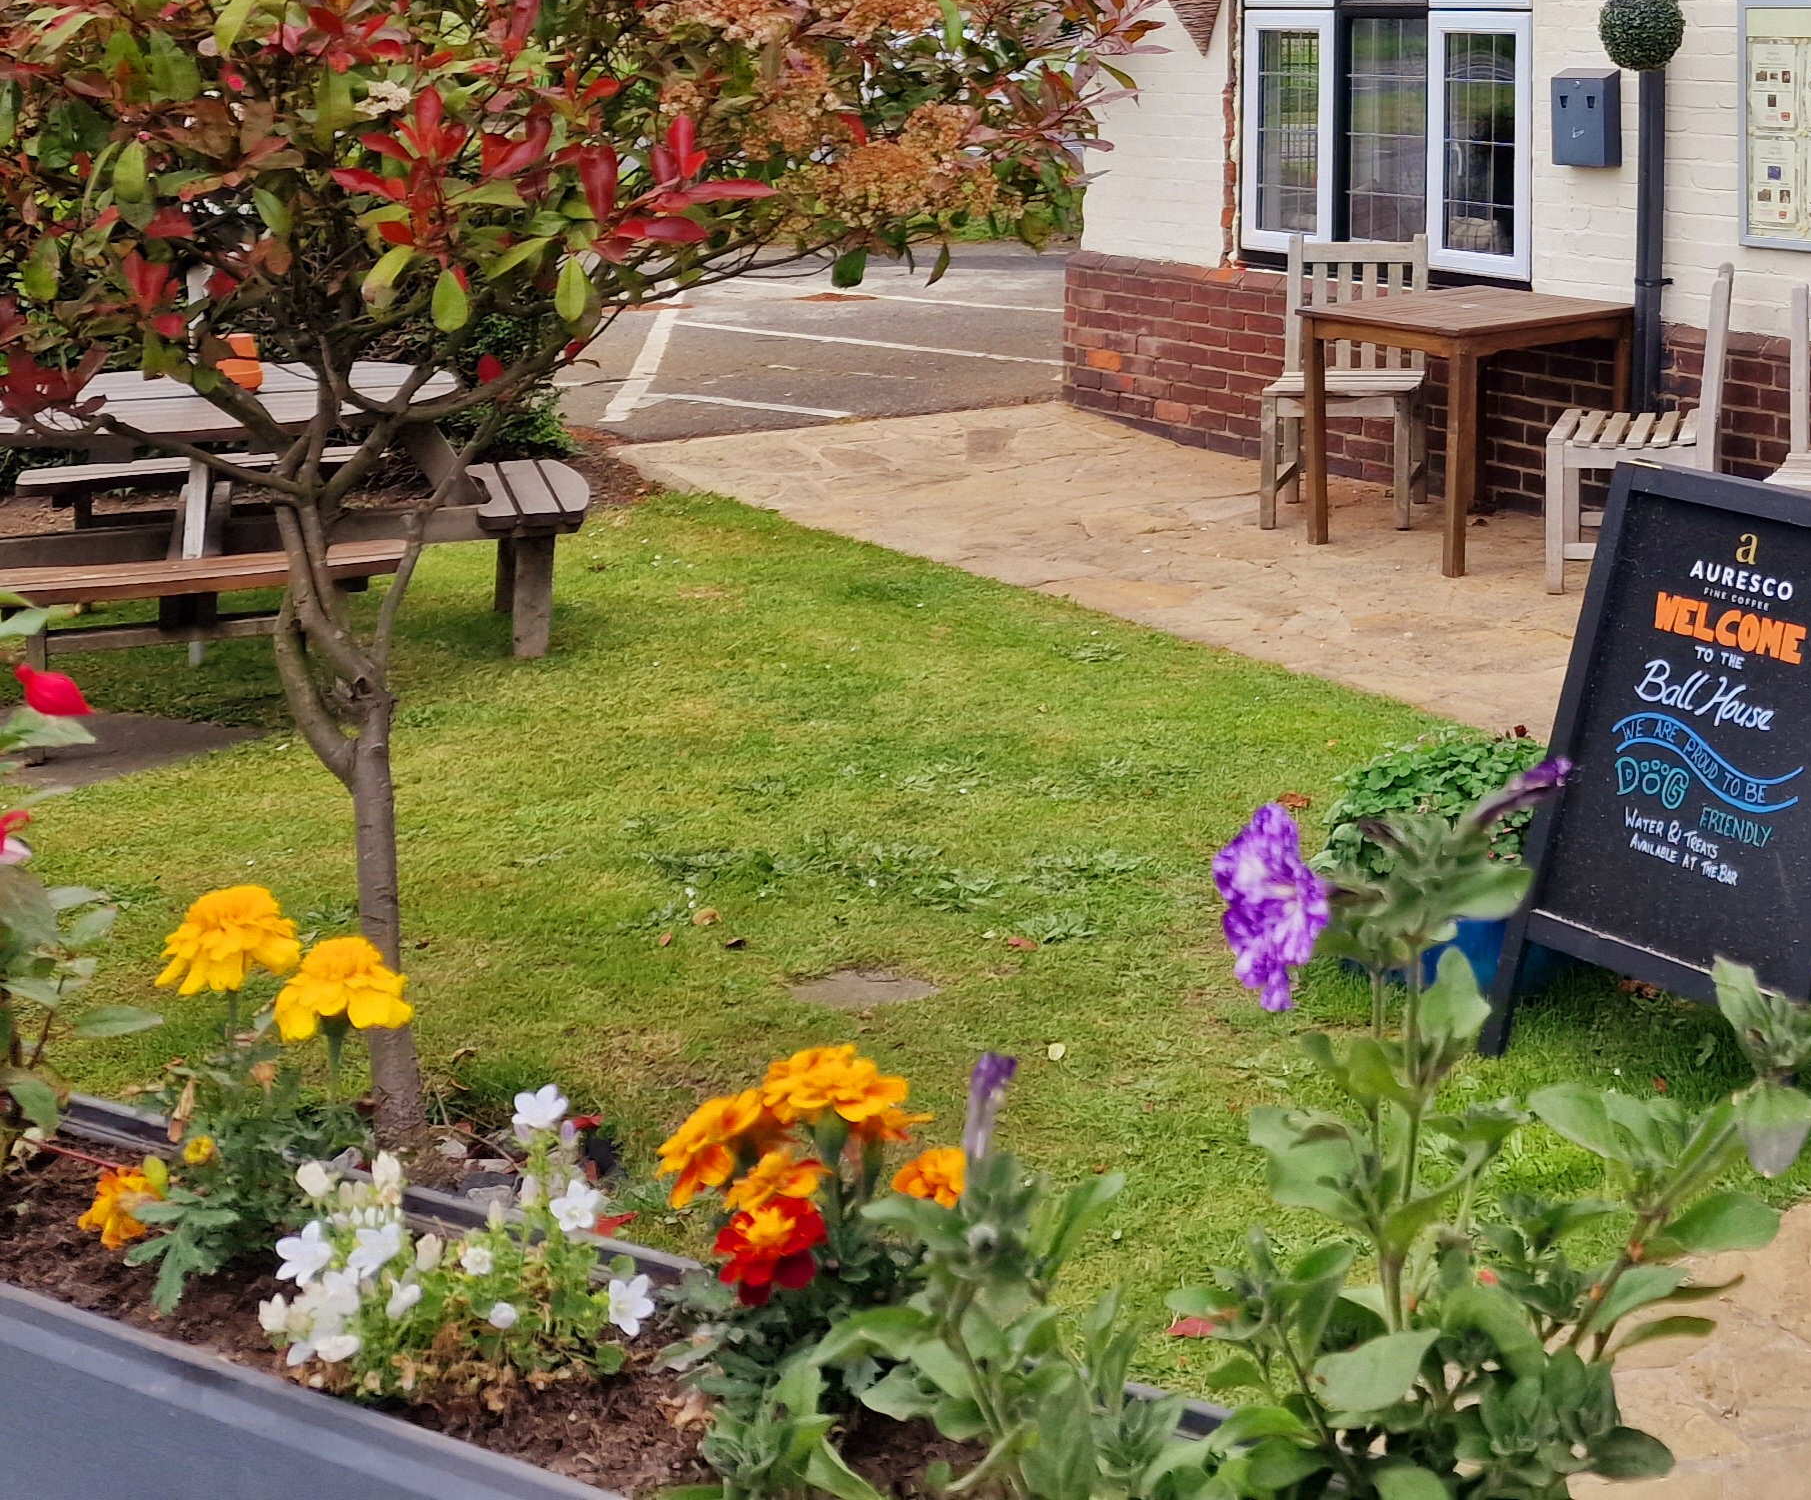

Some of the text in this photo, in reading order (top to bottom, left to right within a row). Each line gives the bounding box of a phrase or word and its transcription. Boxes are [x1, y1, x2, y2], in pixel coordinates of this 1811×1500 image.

[1689, 559, 1794, 601] AURESCO
[1703, 586, 1770, 612] FINE COFFEE
[1654, 591, 1808, 666] WELCOME
[1694, 644, 1746, 670] TO THE
[1633, 659, 1775, 731] Ball House
[1622, 718, 1768, 804] WE ARE PROUD TO BE
[1614, 756, 1773, 848] DOG FRIENDLY
[1667, 819, 1682, 845] &
[1681, 853, 1699, 871] AT
